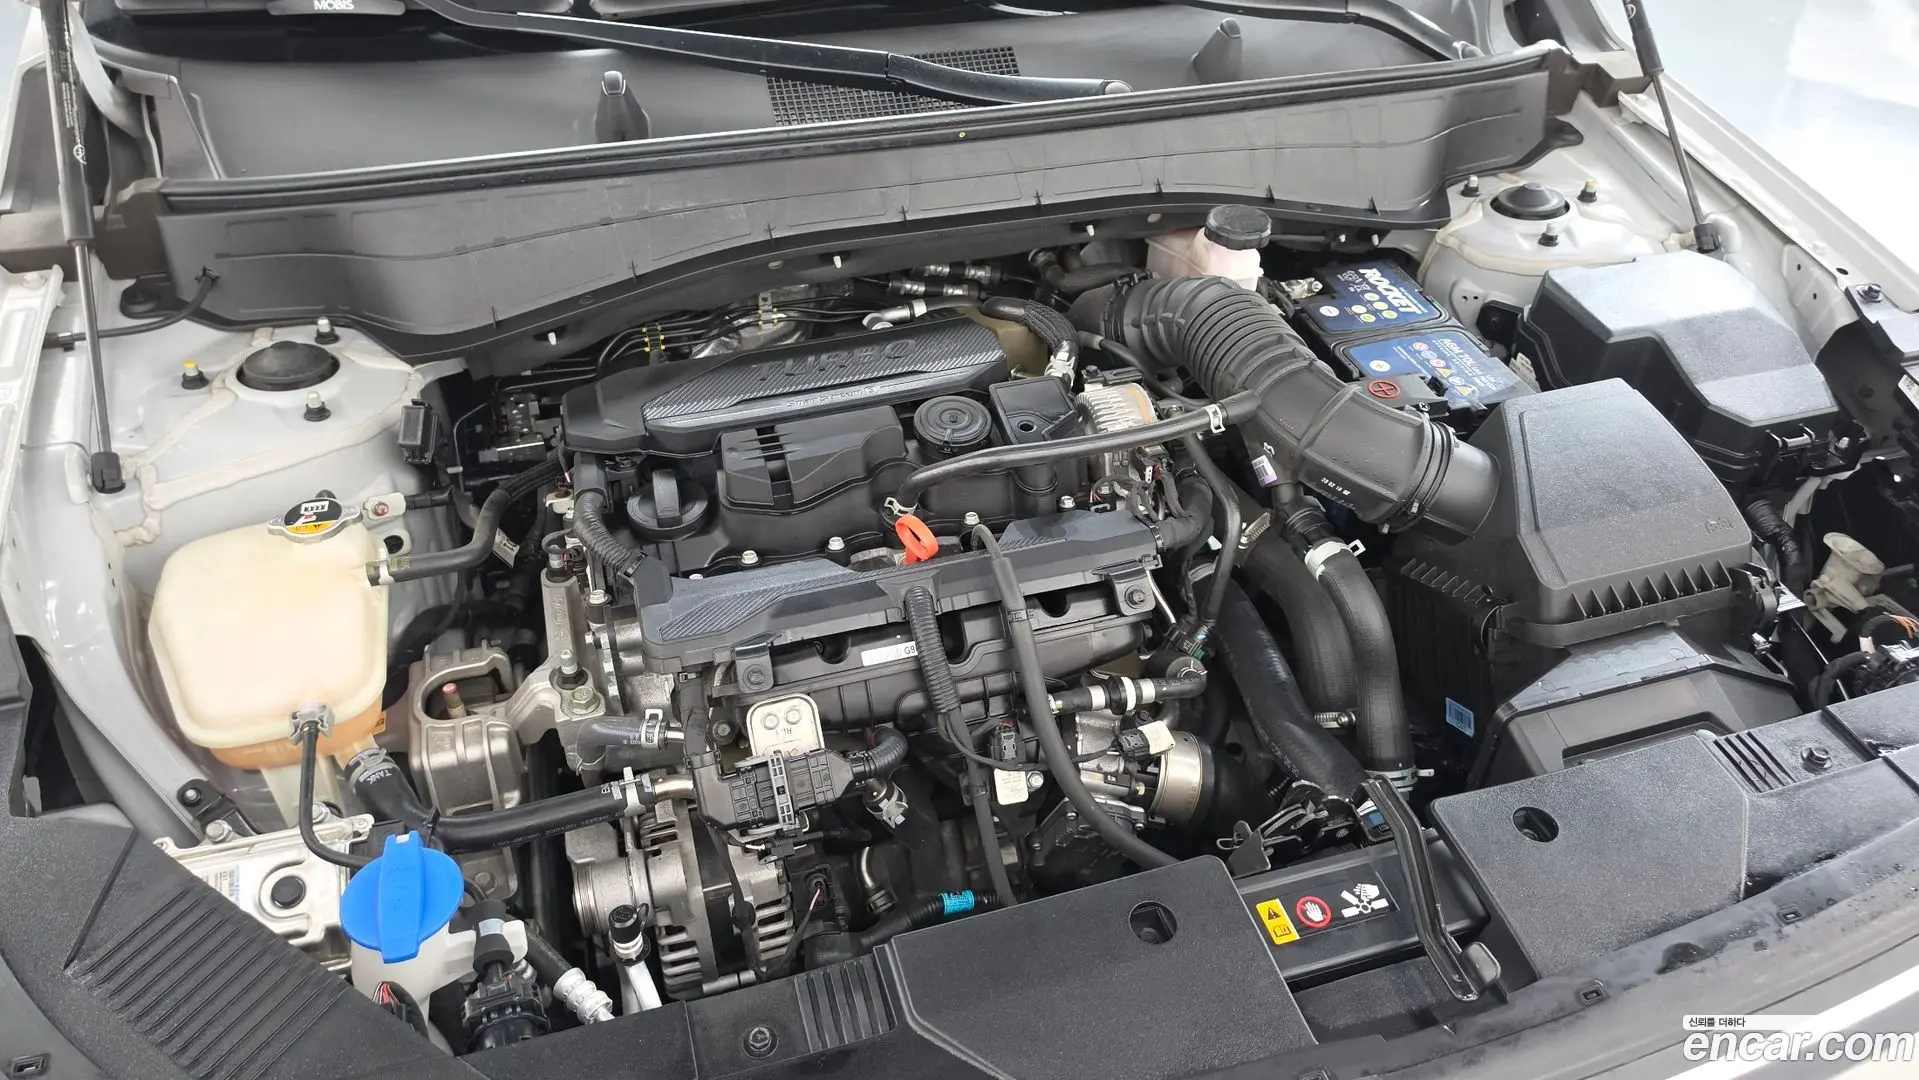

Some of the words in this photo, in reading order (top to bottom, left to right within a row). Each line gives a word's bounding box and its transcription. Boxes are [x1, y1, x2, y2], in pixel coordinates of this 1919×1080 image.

[313, 0, 355, 10] MOBIS
[1358, 267, 1424, 315] ROCKET
[752, 339, 917, 382] TURBO
[366, 769, 392, 784] TANK
